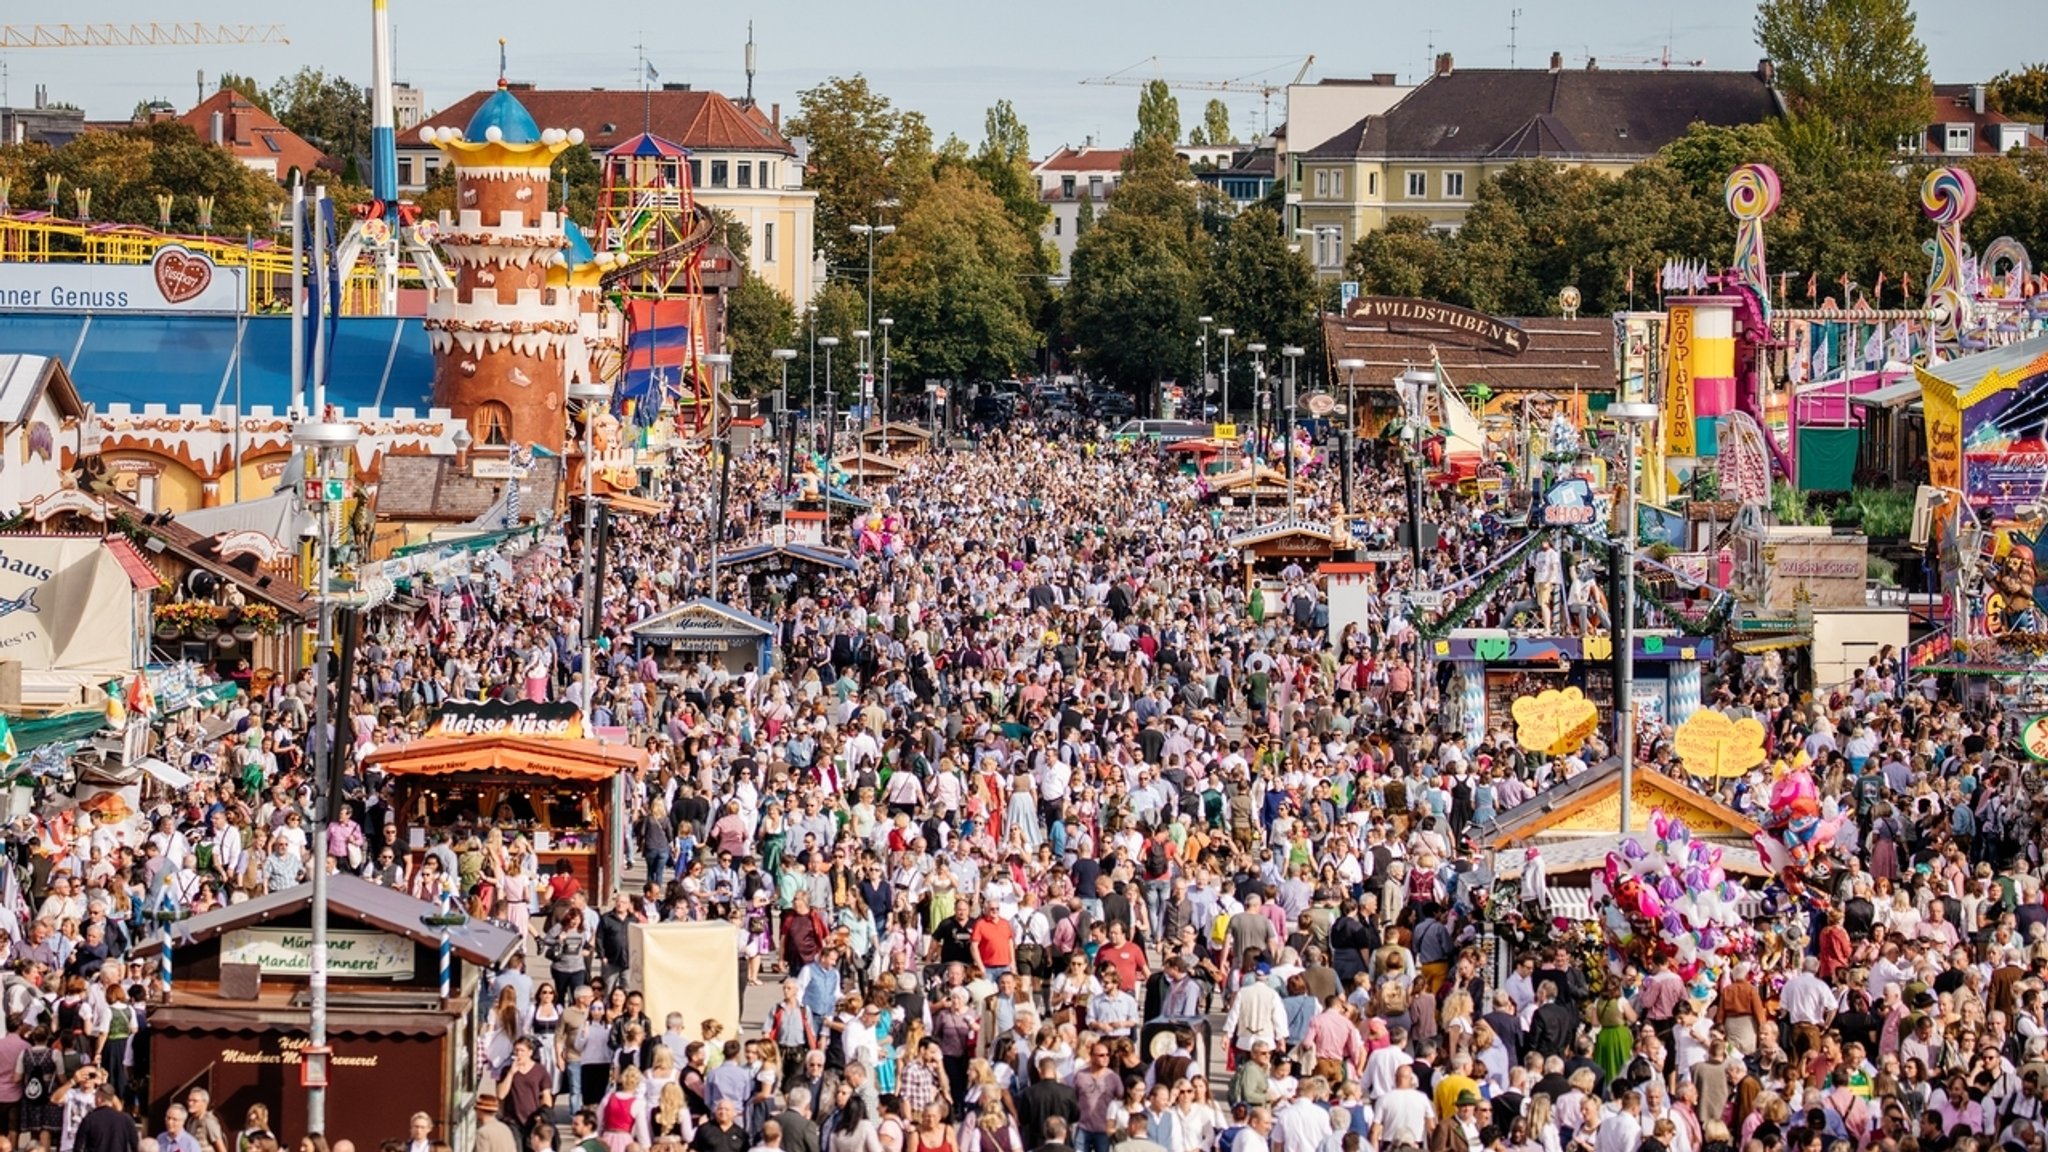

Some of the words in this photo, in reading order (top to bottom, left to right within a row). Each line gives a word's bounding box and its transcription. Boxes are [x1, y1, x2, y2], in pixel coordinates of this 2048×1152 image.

[51, 286, 129, 307] Genuss
[1375, 301, 1503, 340] WILDSTUBEN
[1673, 310, 1690, 362] TOP
[1673, 369, 1689, 438] SPIN
[1546, 506, 1594, 523] SHOP
[676, 618, 723, 630] Mandeln
[681, 640, 719, 651] Mandeln
[440, 713, 505, 734] Heisse
[511, 714, 569, 735] Nüsse
[282, 936, 356, 950] Münner
[258, 955, 378, 970] Mandelennerei
[222, 1050, 281, 1064] Münchner
